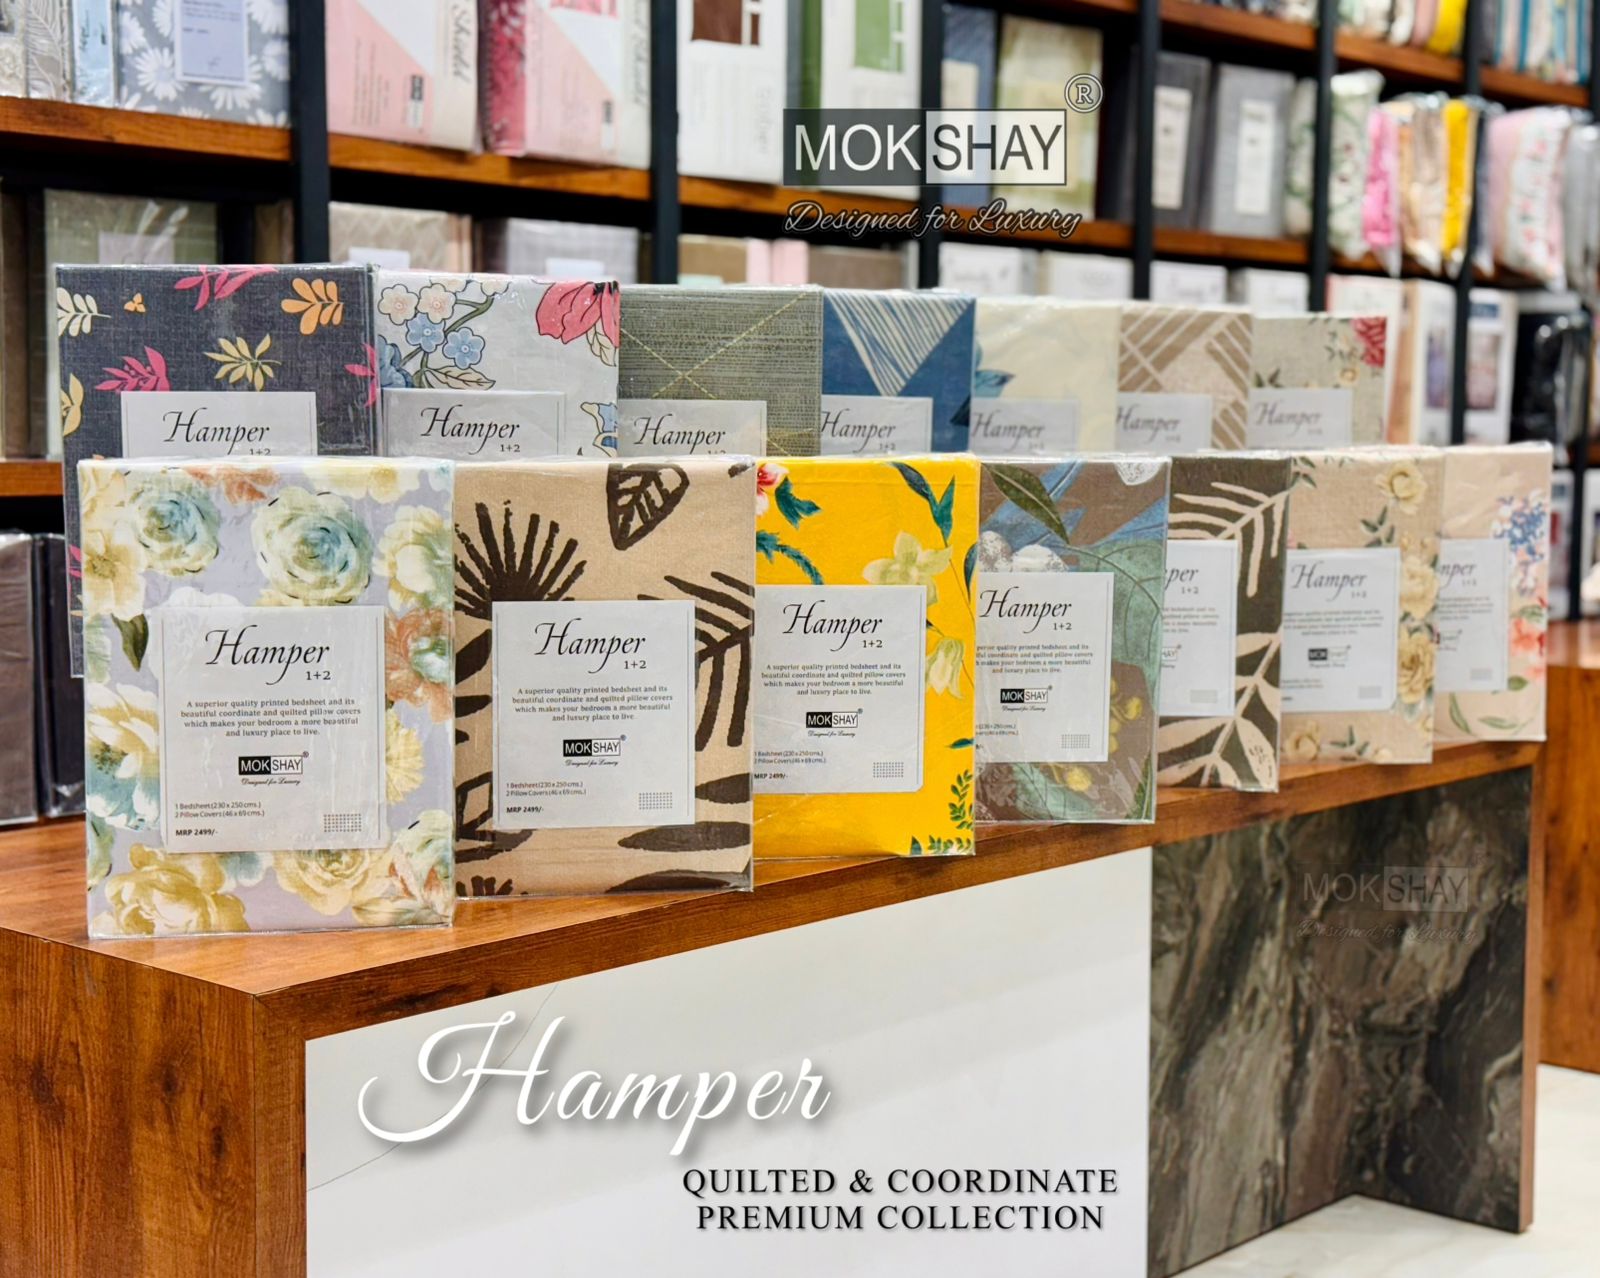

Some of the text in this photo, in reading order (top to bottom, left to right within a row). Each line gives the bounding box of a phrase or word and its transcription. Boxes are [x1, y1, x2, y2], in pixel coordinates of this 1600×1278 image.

[163, 407, 269, 455] Hamper
[421, 404, 520, 455] Hamper
[633, 414, 725, 454] Hamper
[821, 408, 896, 453] Hamper
[972, 409, 1045, 452] Hamper
[1116, 403, 1180, 444] Hamper
[1255, 399, 1322, 437] Hamper
[1291, 560, 1367, 602] Hamper
[782, 600, 882, 652] Hamper
[980, 586, 1072, 633] Hamper
[205, 624, 330, 685] Hamper
[534, 618, 646, 674] Hamper
[624, 661, 647, 669] 1+2
[306, 671, 331, 680] 1+2
[195, 701, 228, 709] superior
[231, 700, 258, 708] quality
[261, 699, 289, 708] printed
[280, 709, 307, 718] quilted
[310, 709, 334, 717] pillow
[601, 696, 624, 704] quilted
[1001, 691, 1047, 702] MOKSHAY
[243, 730, 268, 738] luxury
[270, 729, 290, 737] place
[807, 714, 857, 726] MOKSHAY
[240, 759, 301, 772] MOKSHAY
[564, 742, 620, 755] MOKSHAY
